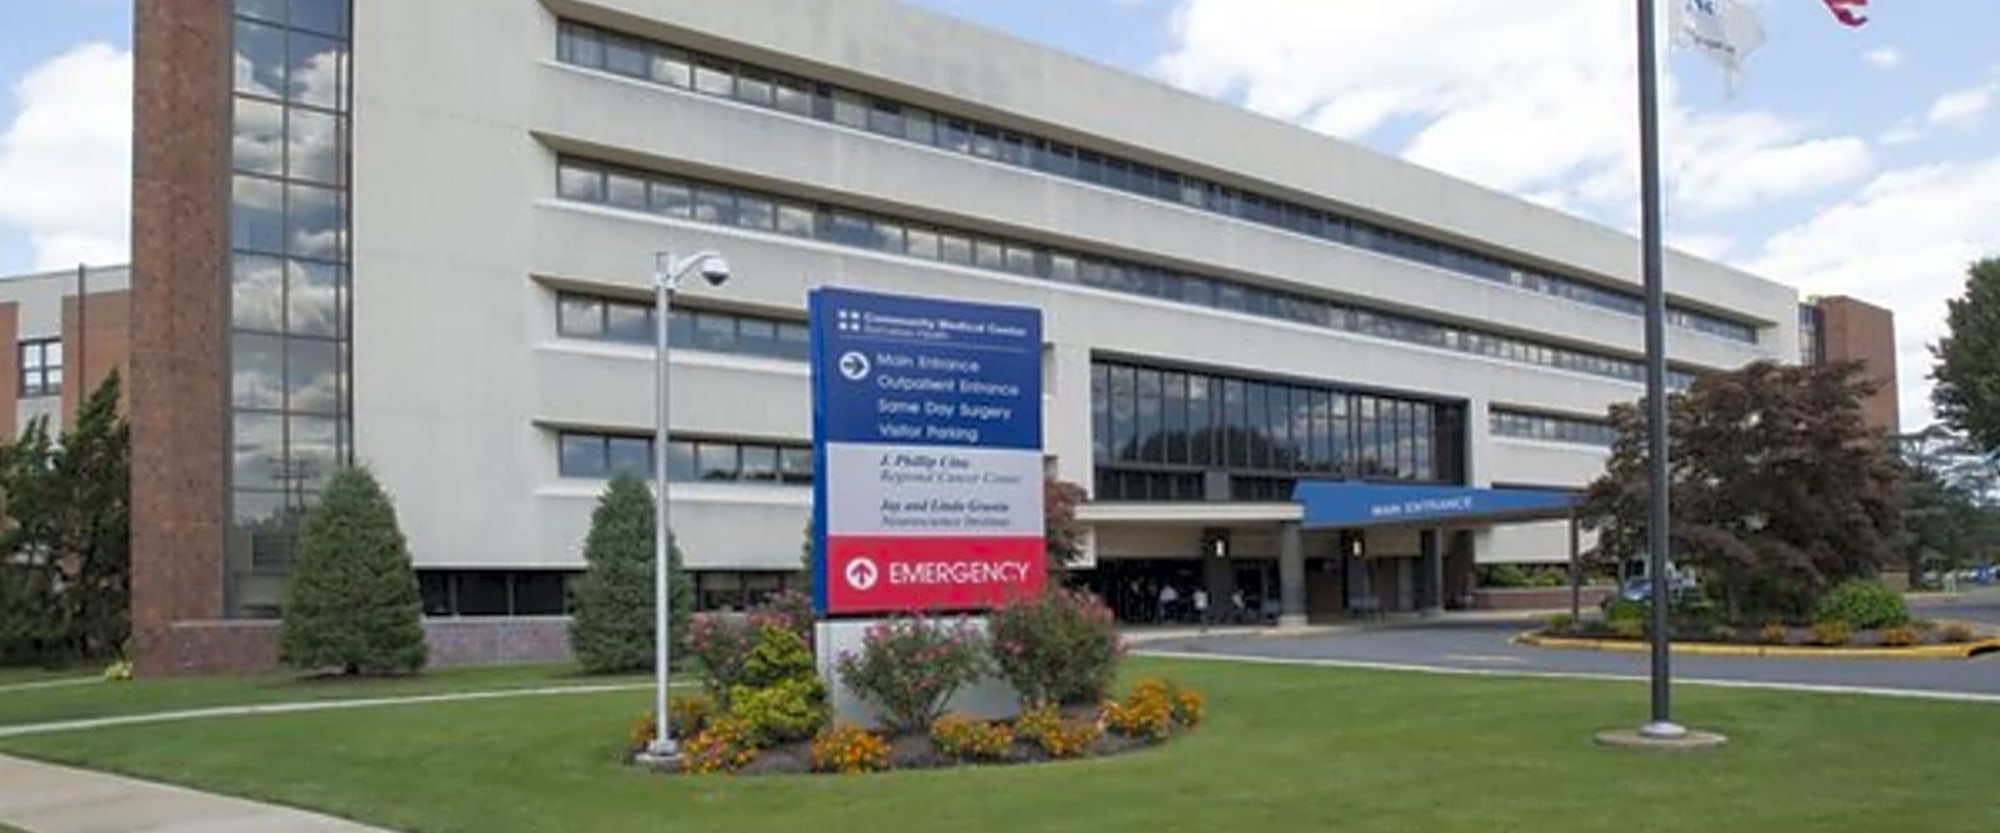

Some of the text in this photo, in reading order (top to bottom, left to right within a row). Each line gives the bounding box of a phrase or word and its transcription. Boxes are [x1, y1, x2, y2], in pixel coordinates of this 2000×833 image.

[876, 353, 981, 373] Main Entrance
[876, 375, 1020, 396] Outpatient Entrance
[878, 399, 1012, 420] Same Day Surgery
[879, 423, 979, 443] Visitor Parking
[889, 561, 1030, 584] EMERGENCY
